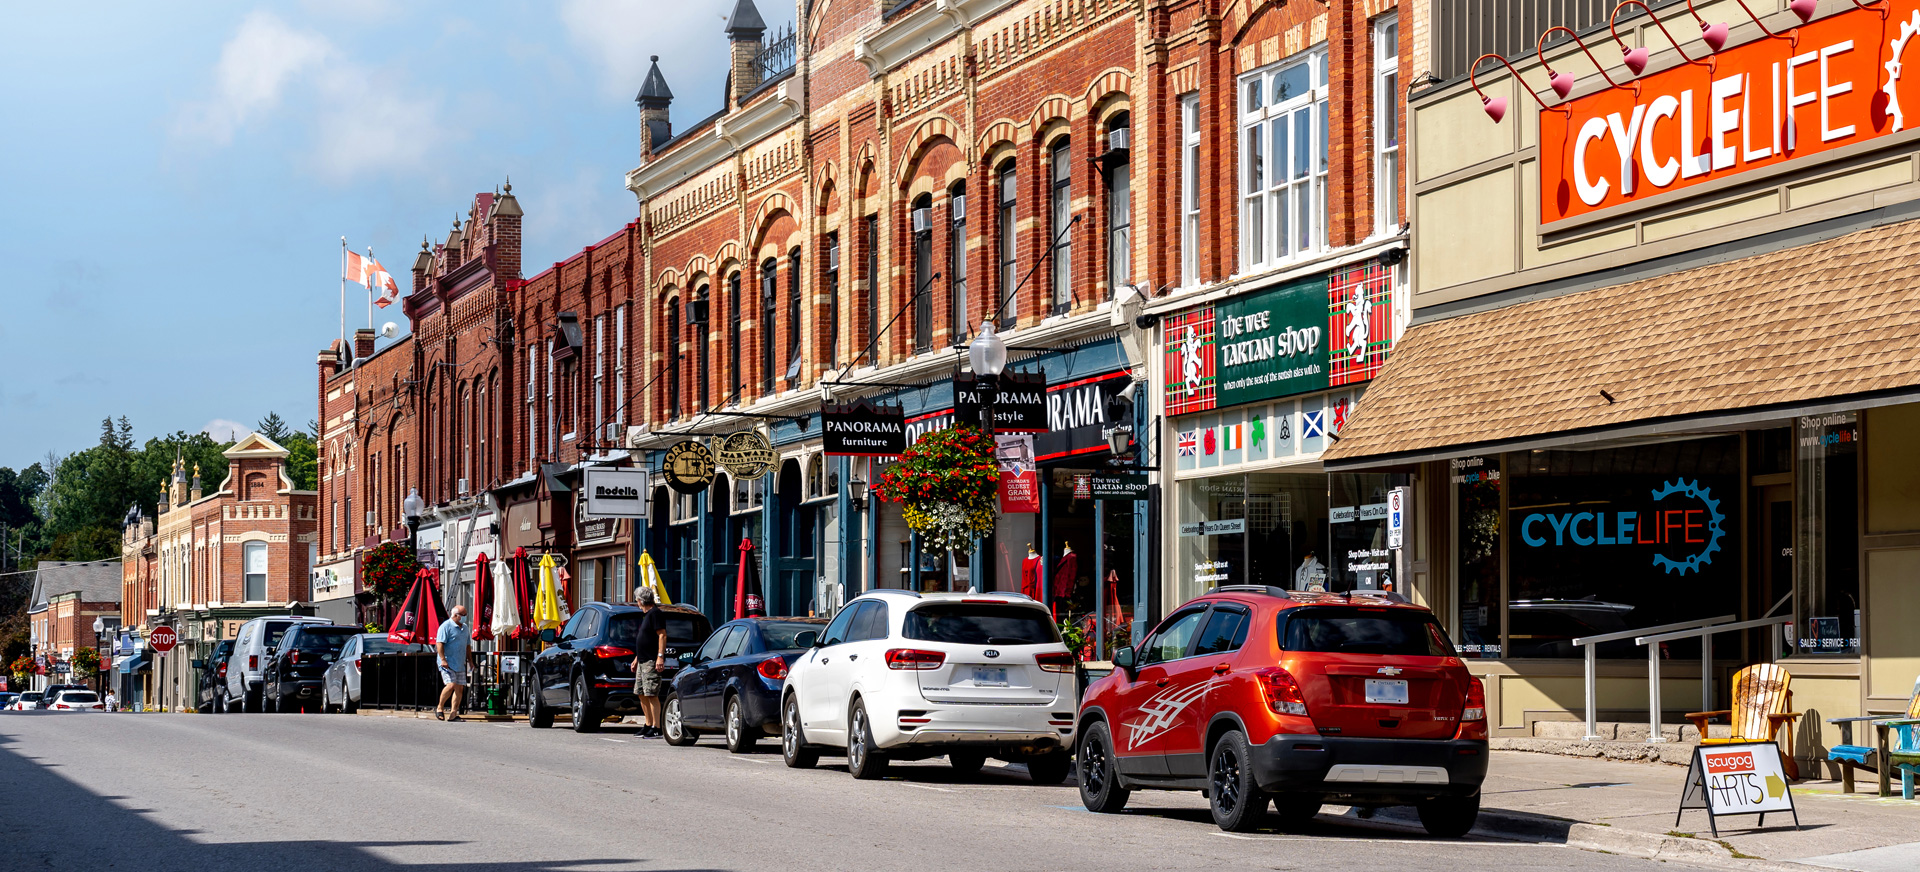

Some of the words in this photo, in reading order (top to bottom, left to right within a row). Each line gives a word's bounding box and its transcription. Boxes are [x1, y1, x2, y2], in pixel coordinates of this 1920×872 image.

[1573, 39, 1856, 206] CYCLELIFE
[1221, 336, 1275, 368] TARTAN
[1236, 377, 1246, 389] only
[1304, 364, 1313, 376] will
[826, 420, 902, 433] PANORAMA
[1801, 416, 1821, 430] Shop
[1822, 413, 1847, 427] online
[842, 436, 888, 447] furniture
[663, 442, 687, 470] PORT
[690, 442, 715, 484] SOCIAL
[1451, 458, 1466, 470] Shop
[1466, 456, 1484, 468] online
[596, 486, 638, 496] Modella
[1333, 510, 1354, 520] Celebrating
[1372, 507, 1379, 516] On
[1379, 506, 1388, 514] Que
[1521, 509, 1705, 548] CYCLELIFE
[1348, 550, 1358, 560] Shop
[1358, 549, 1370, 558] Online
[1782, 548, 1793, 556] OPE
[152, 634, 176, 645] STOP
[1800, 638, 1817, 648] SALES
[1822, 638, 1844, 648] SERVICE
[1850, 638, 1860, 647] REN
[1708, 755, 1754, 770] scugog
[1710, 772, 1764, 807] ARTS
